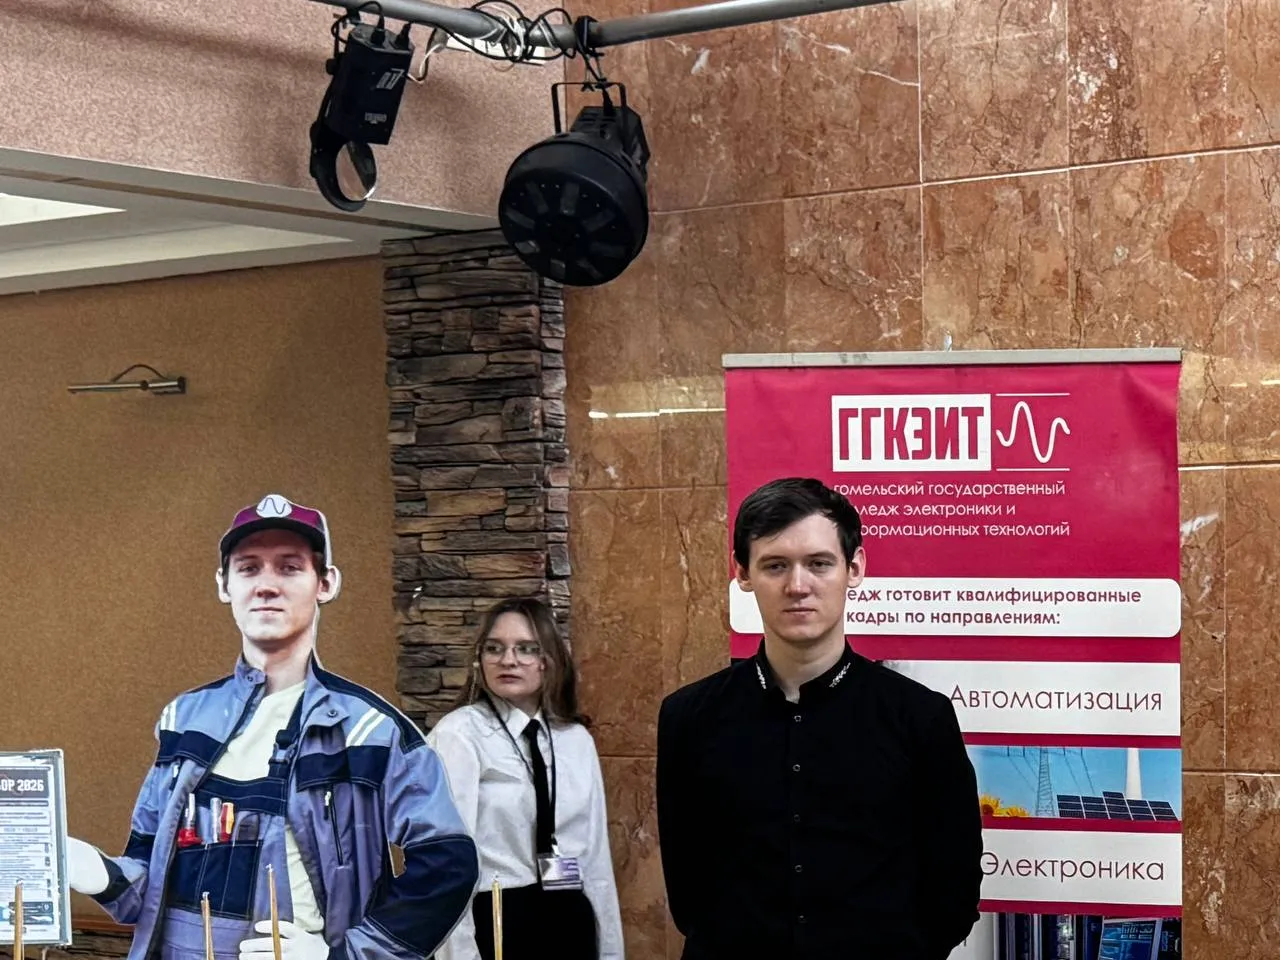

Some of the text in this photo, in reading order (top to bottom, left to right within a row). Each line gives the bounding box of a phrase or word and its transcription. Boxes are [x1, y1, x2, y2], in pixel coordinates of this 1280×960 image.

[838, 407, 985, 460] ГГКЭИТ
[834, 481, 1066, 498] гомельский государственный
[903, 504, 1002, 518] электроники
[1006, 505, 1016, 516] и
[983, 521, 1070, 537] технологий
[886, 590, 952, 601] готовит
[956, 588, 1142, 605] квалифицированные
[846, 611, 1061, 626] кадры по направлениям:
[950, 685, 1163, 713] Автоматизация
[981, 852, 1164, 882] Электроника
